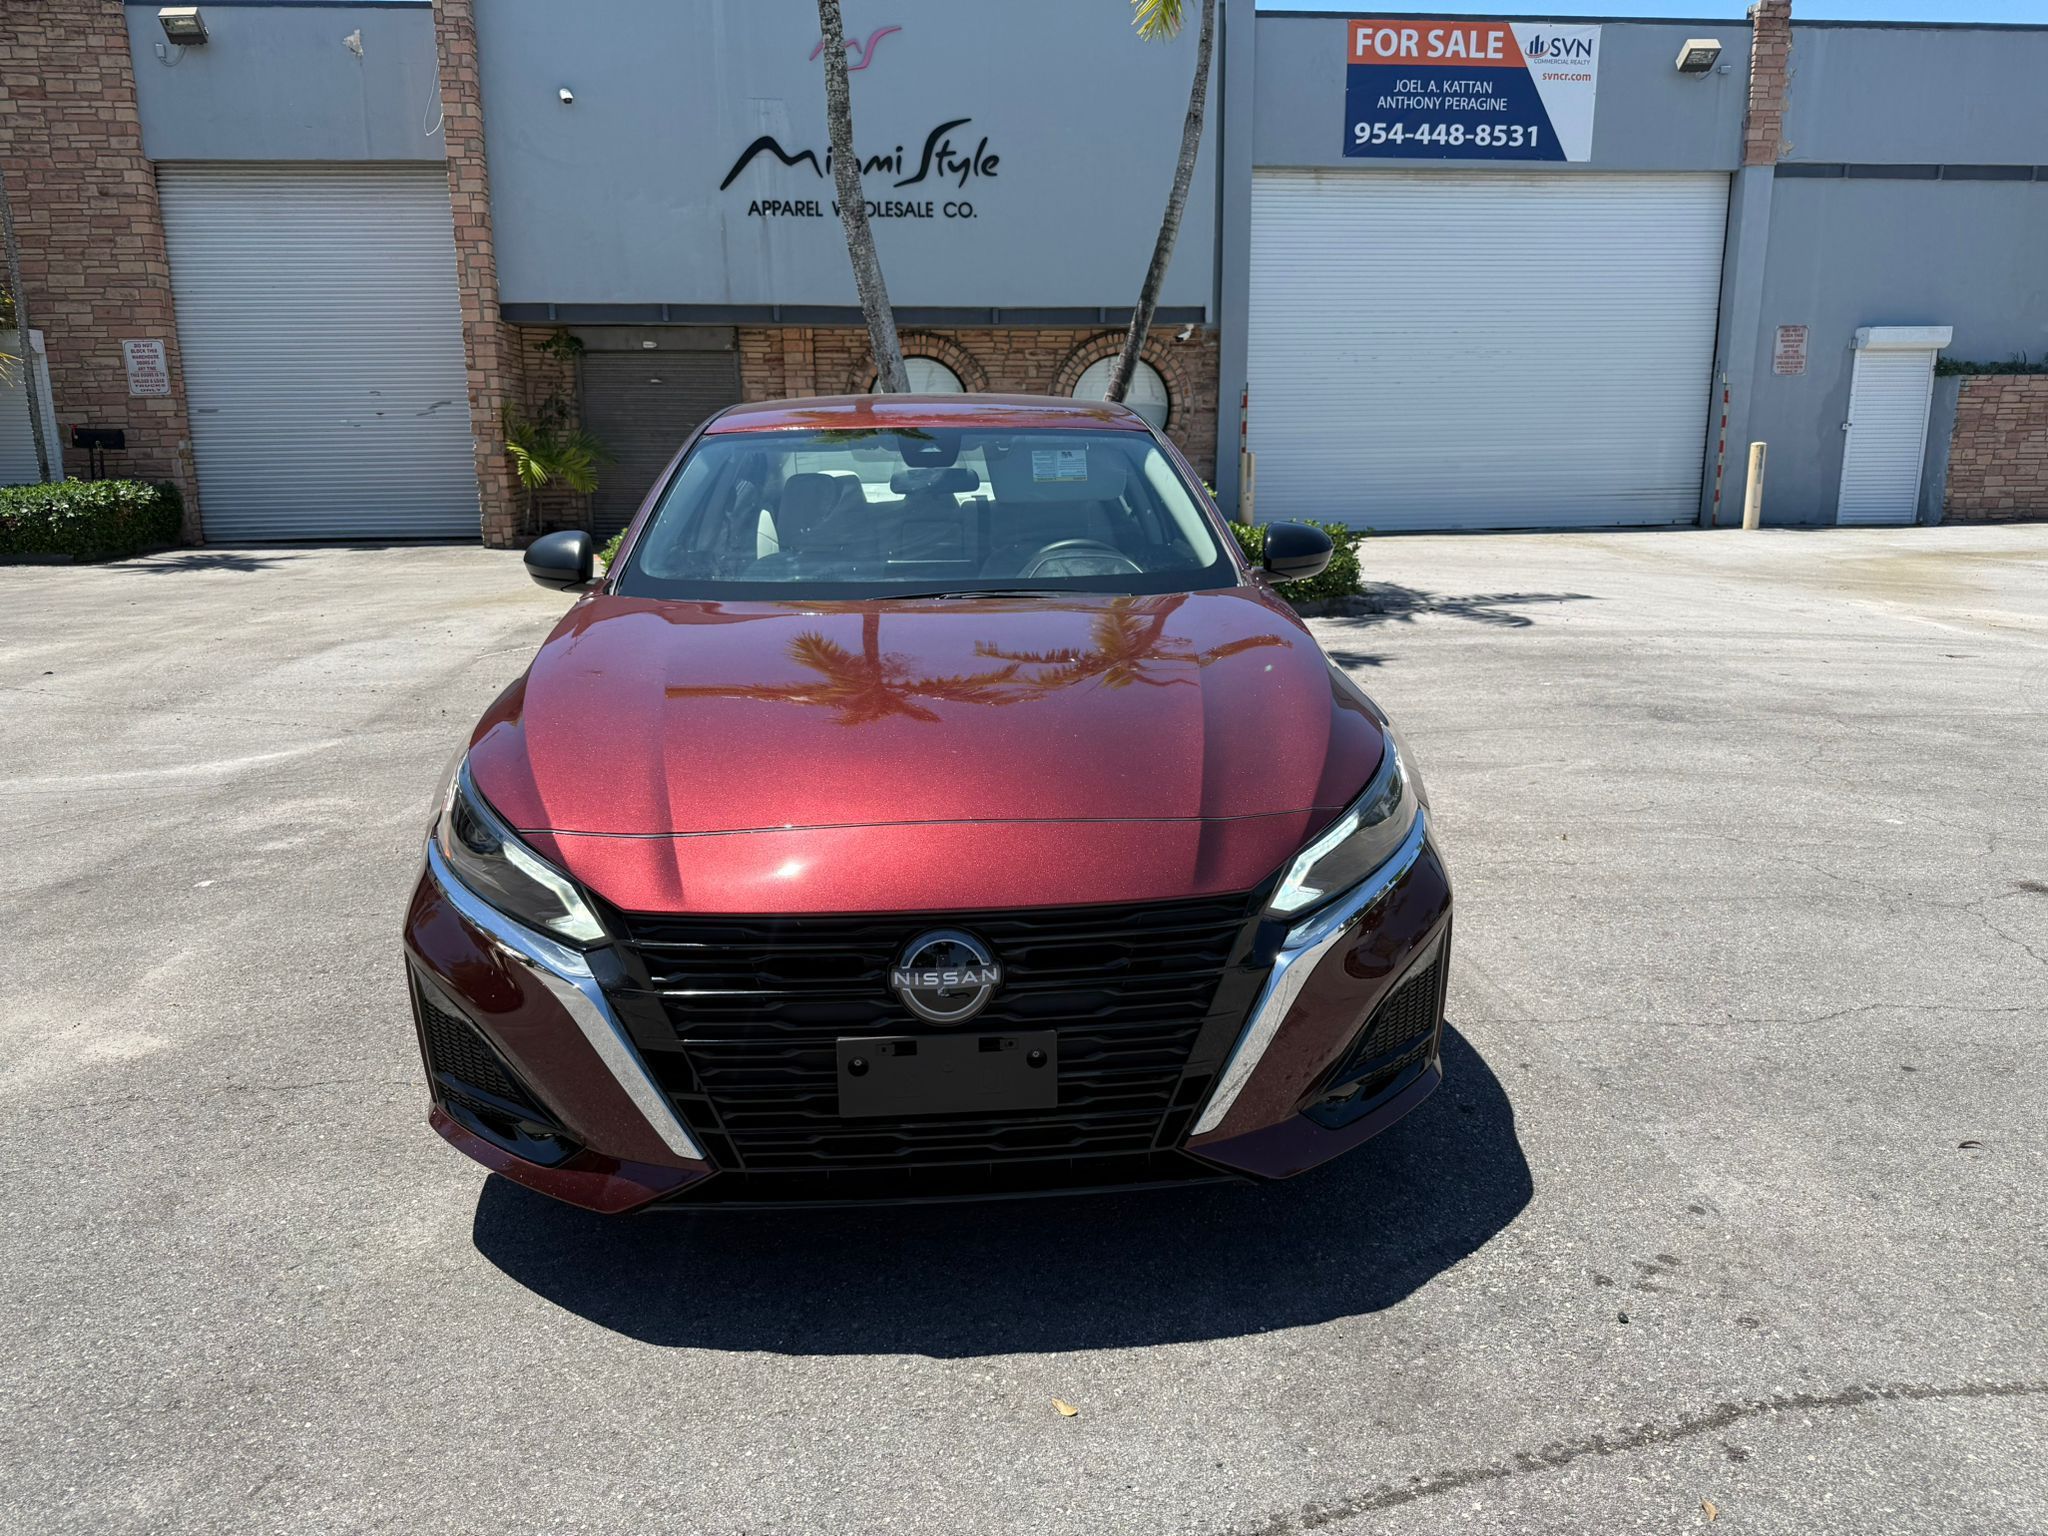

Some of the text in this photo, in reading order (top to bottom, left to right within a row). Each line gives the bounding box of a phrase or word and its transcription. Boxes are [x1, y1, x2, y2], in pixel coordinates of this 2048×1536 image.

[1355, 28, 1505, 59] FOR SALE
[1550, 37, 1593, 58] SVN
[1542, 72, 1592, 81] svncr.com
[1393, 79, 1493, 94] JOEL A. KATTAN
[1377, 96, 1508, 111] ANTHONY PERAGINE
[1353, 122, 1539, 147] 954-448-8531
[720, 118, 1000, 191] Mimi Style
[748, 200, 823, 217] APPAREL
[943, 202, 978, 218] CO.
[894, 967, 998, 986] NISSAN
